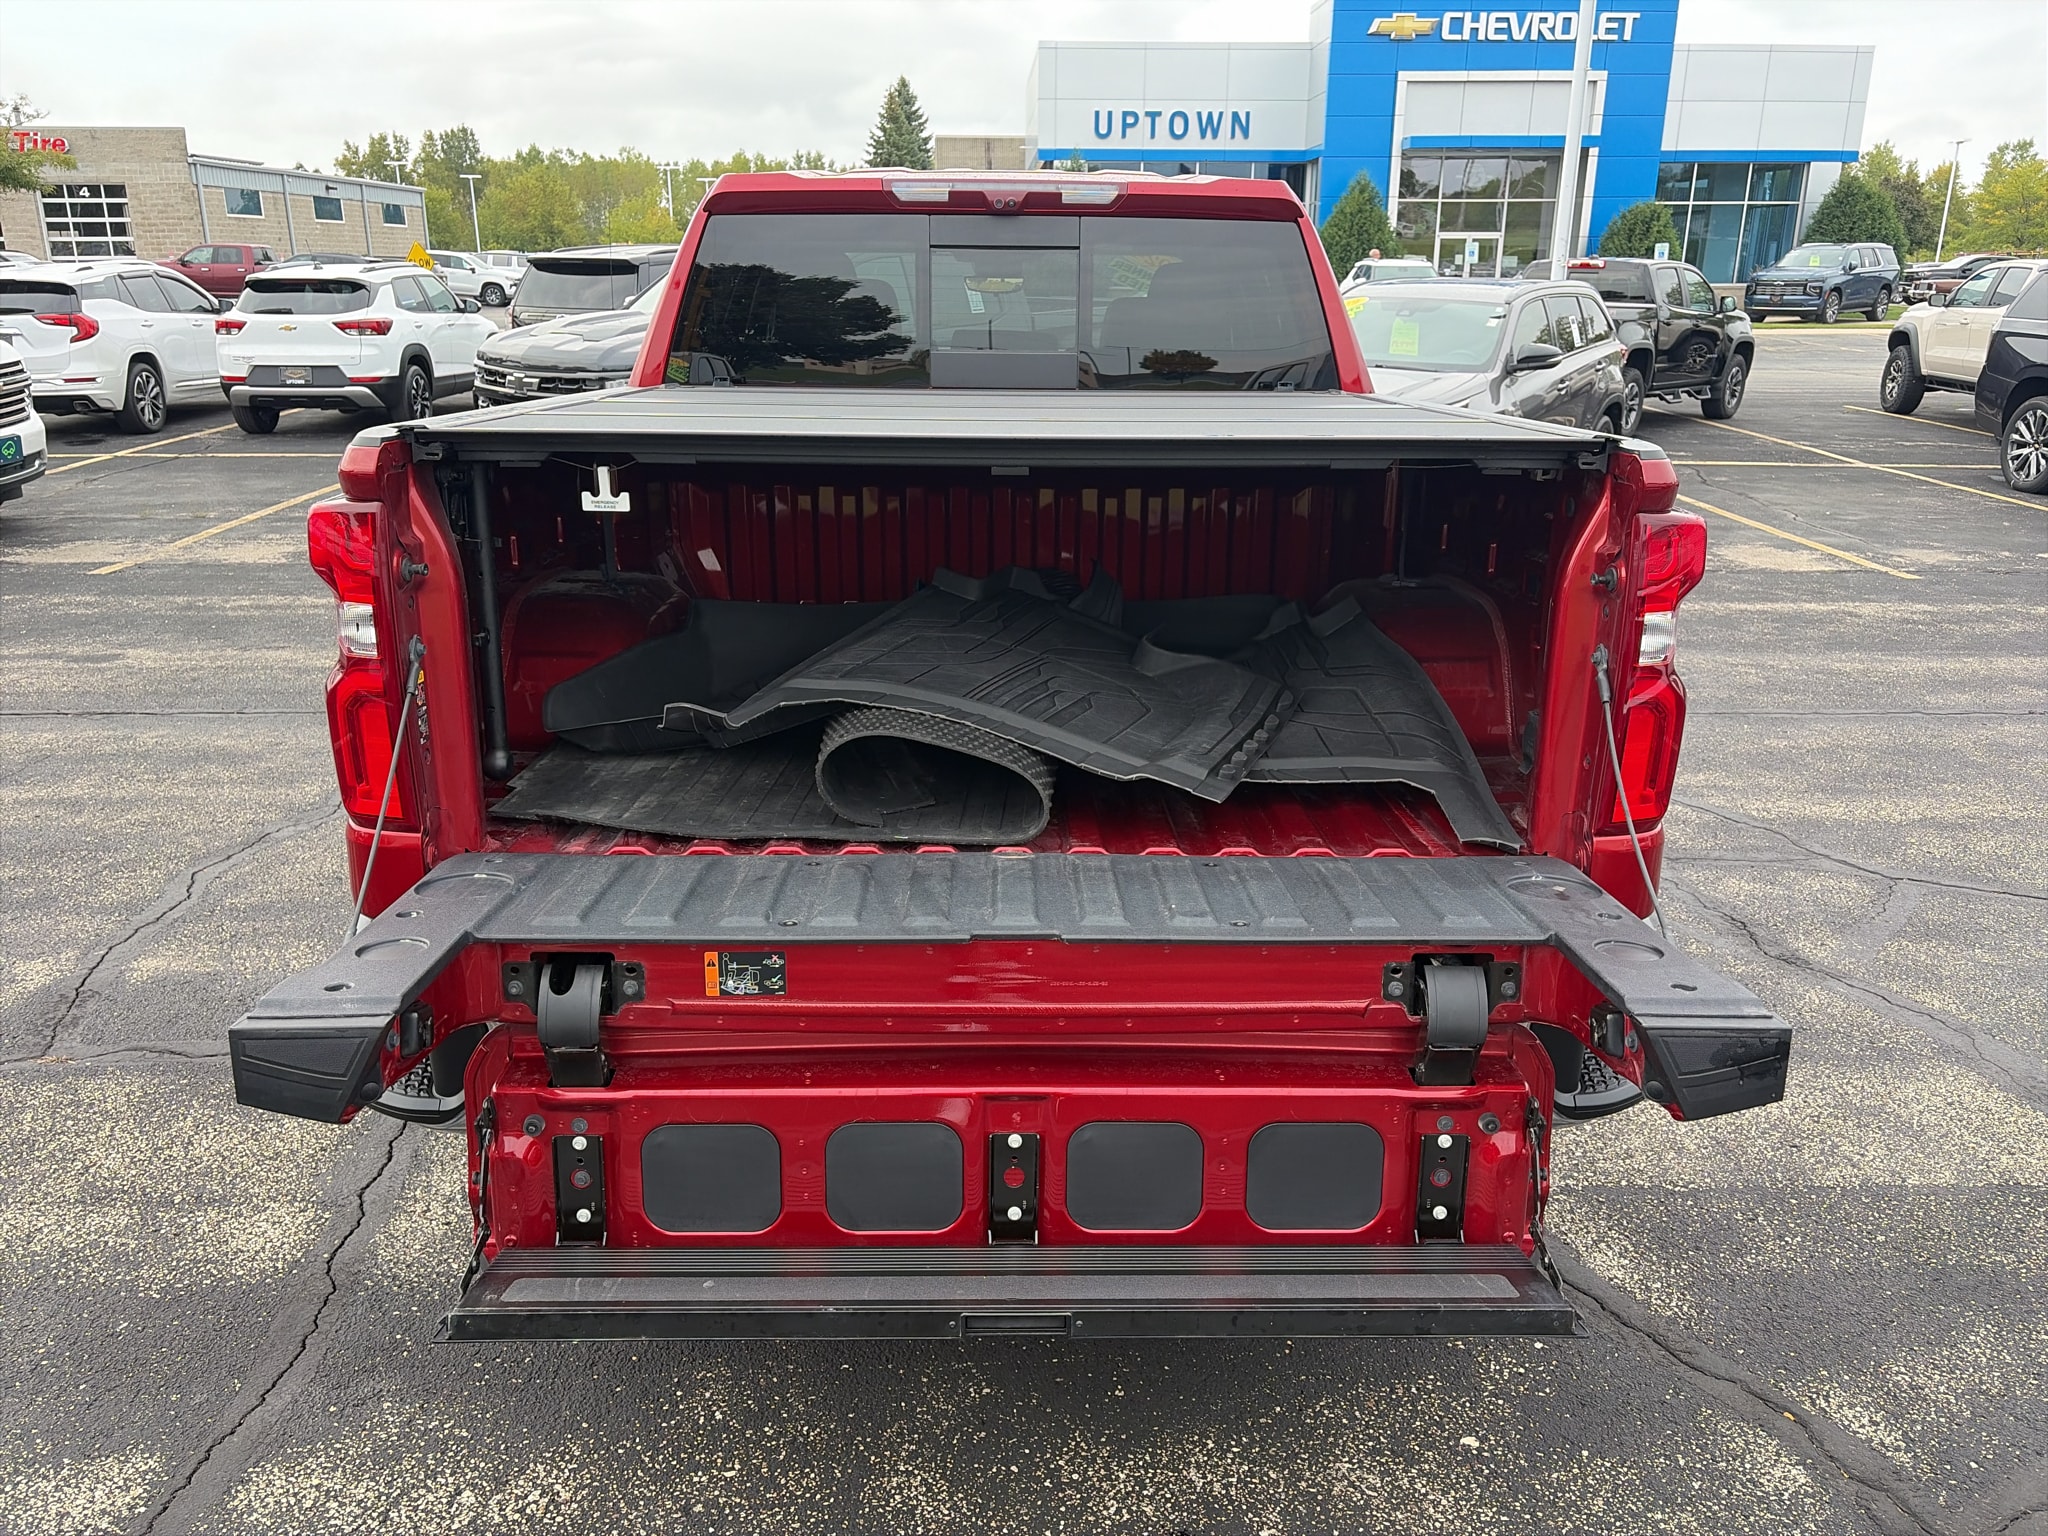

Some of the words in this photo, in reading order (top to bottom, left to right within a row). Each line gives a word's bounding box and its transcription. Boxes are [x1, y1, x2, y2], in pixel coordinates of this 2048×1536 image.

[1441, 12, 1641, 41] CHEVROET
[1094, 110, 1250, 140] UPTOWN
[13, 131, 68, 154] Tire
[79, 186, 90, 198] 4
